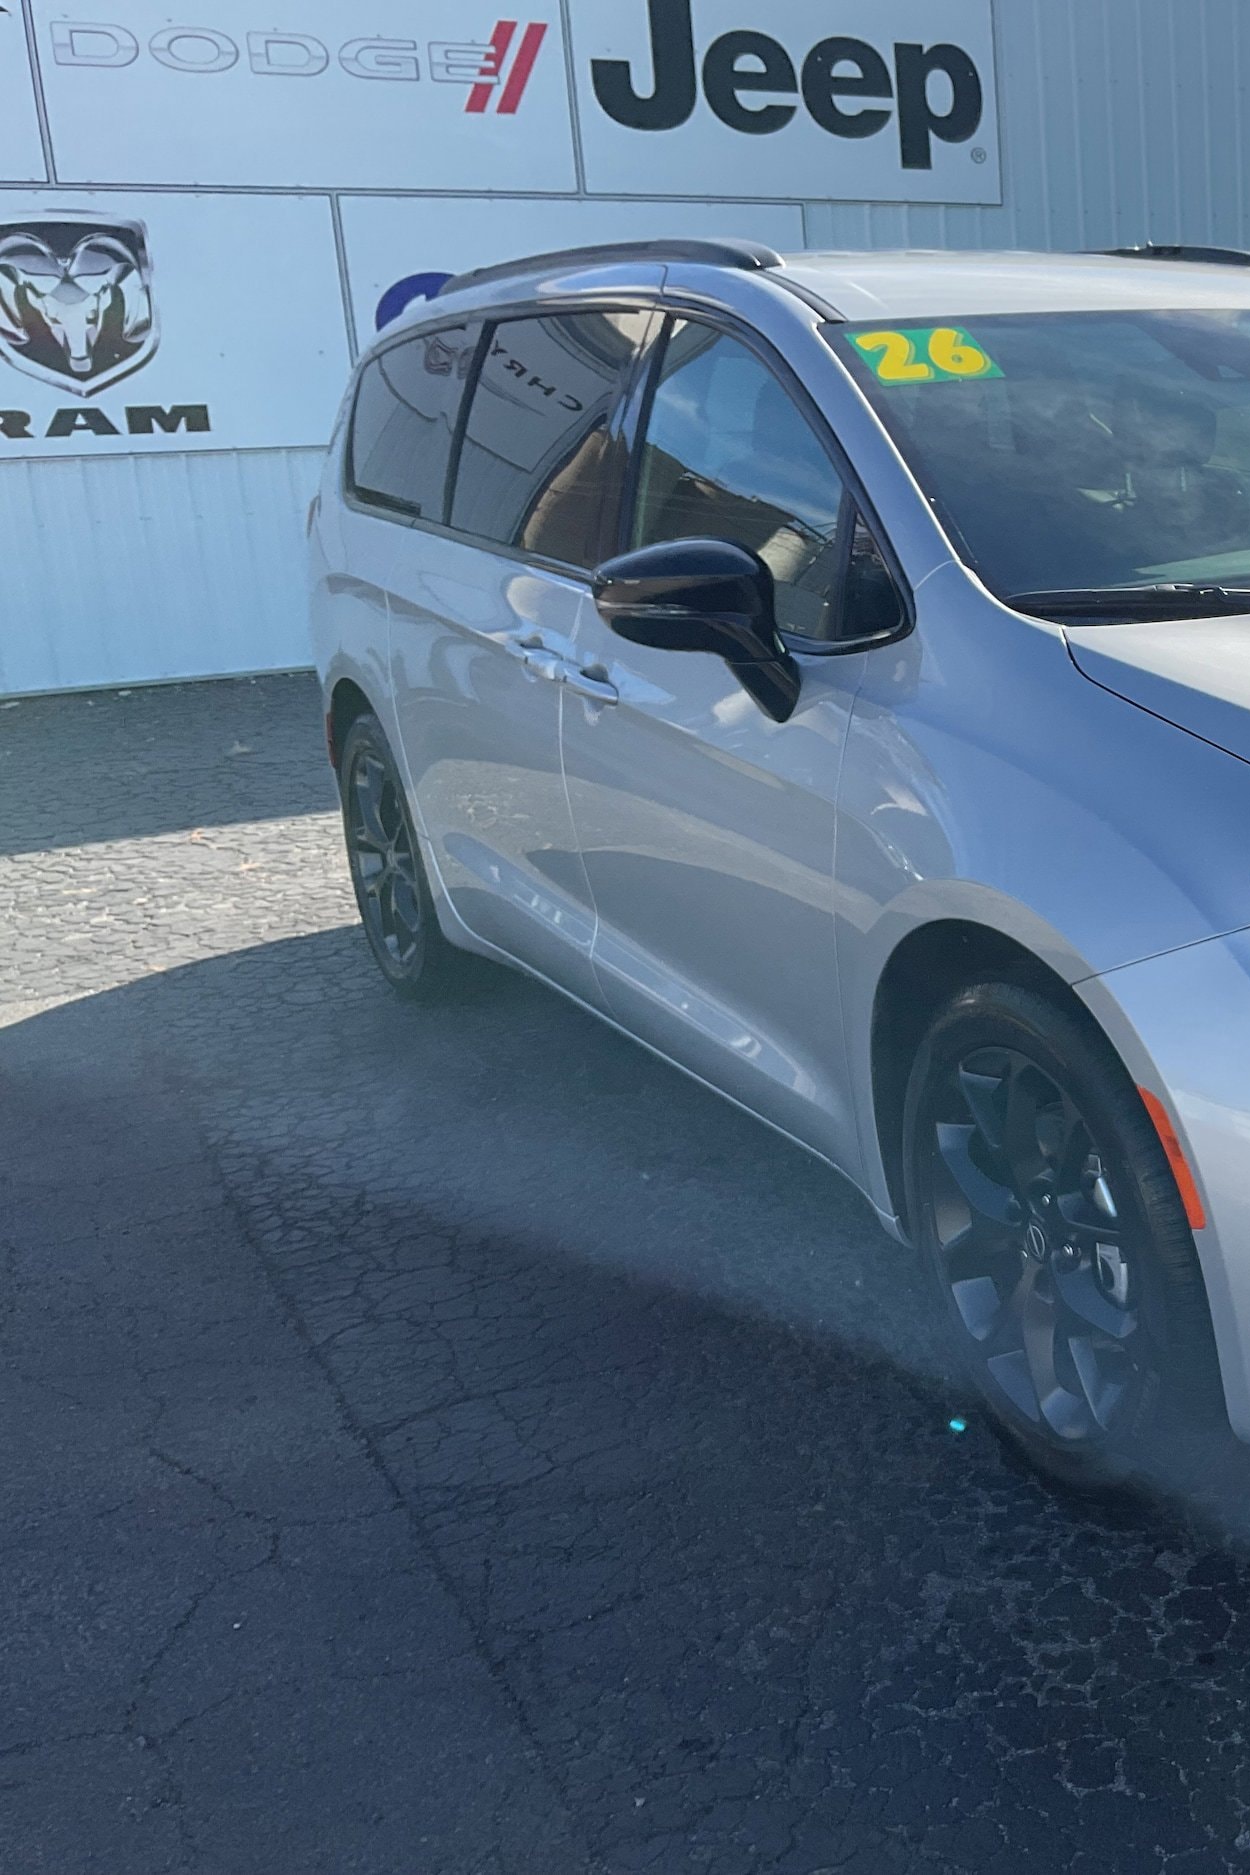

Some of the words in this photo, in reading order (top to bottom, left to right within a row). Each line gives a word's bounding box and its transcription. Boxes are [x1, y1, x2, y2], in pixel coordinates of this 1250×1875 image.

[50, 20, 500, 84] DODGE
[591, 0, 982, 170] Jeep
[855, 328, 992, 382] 26
